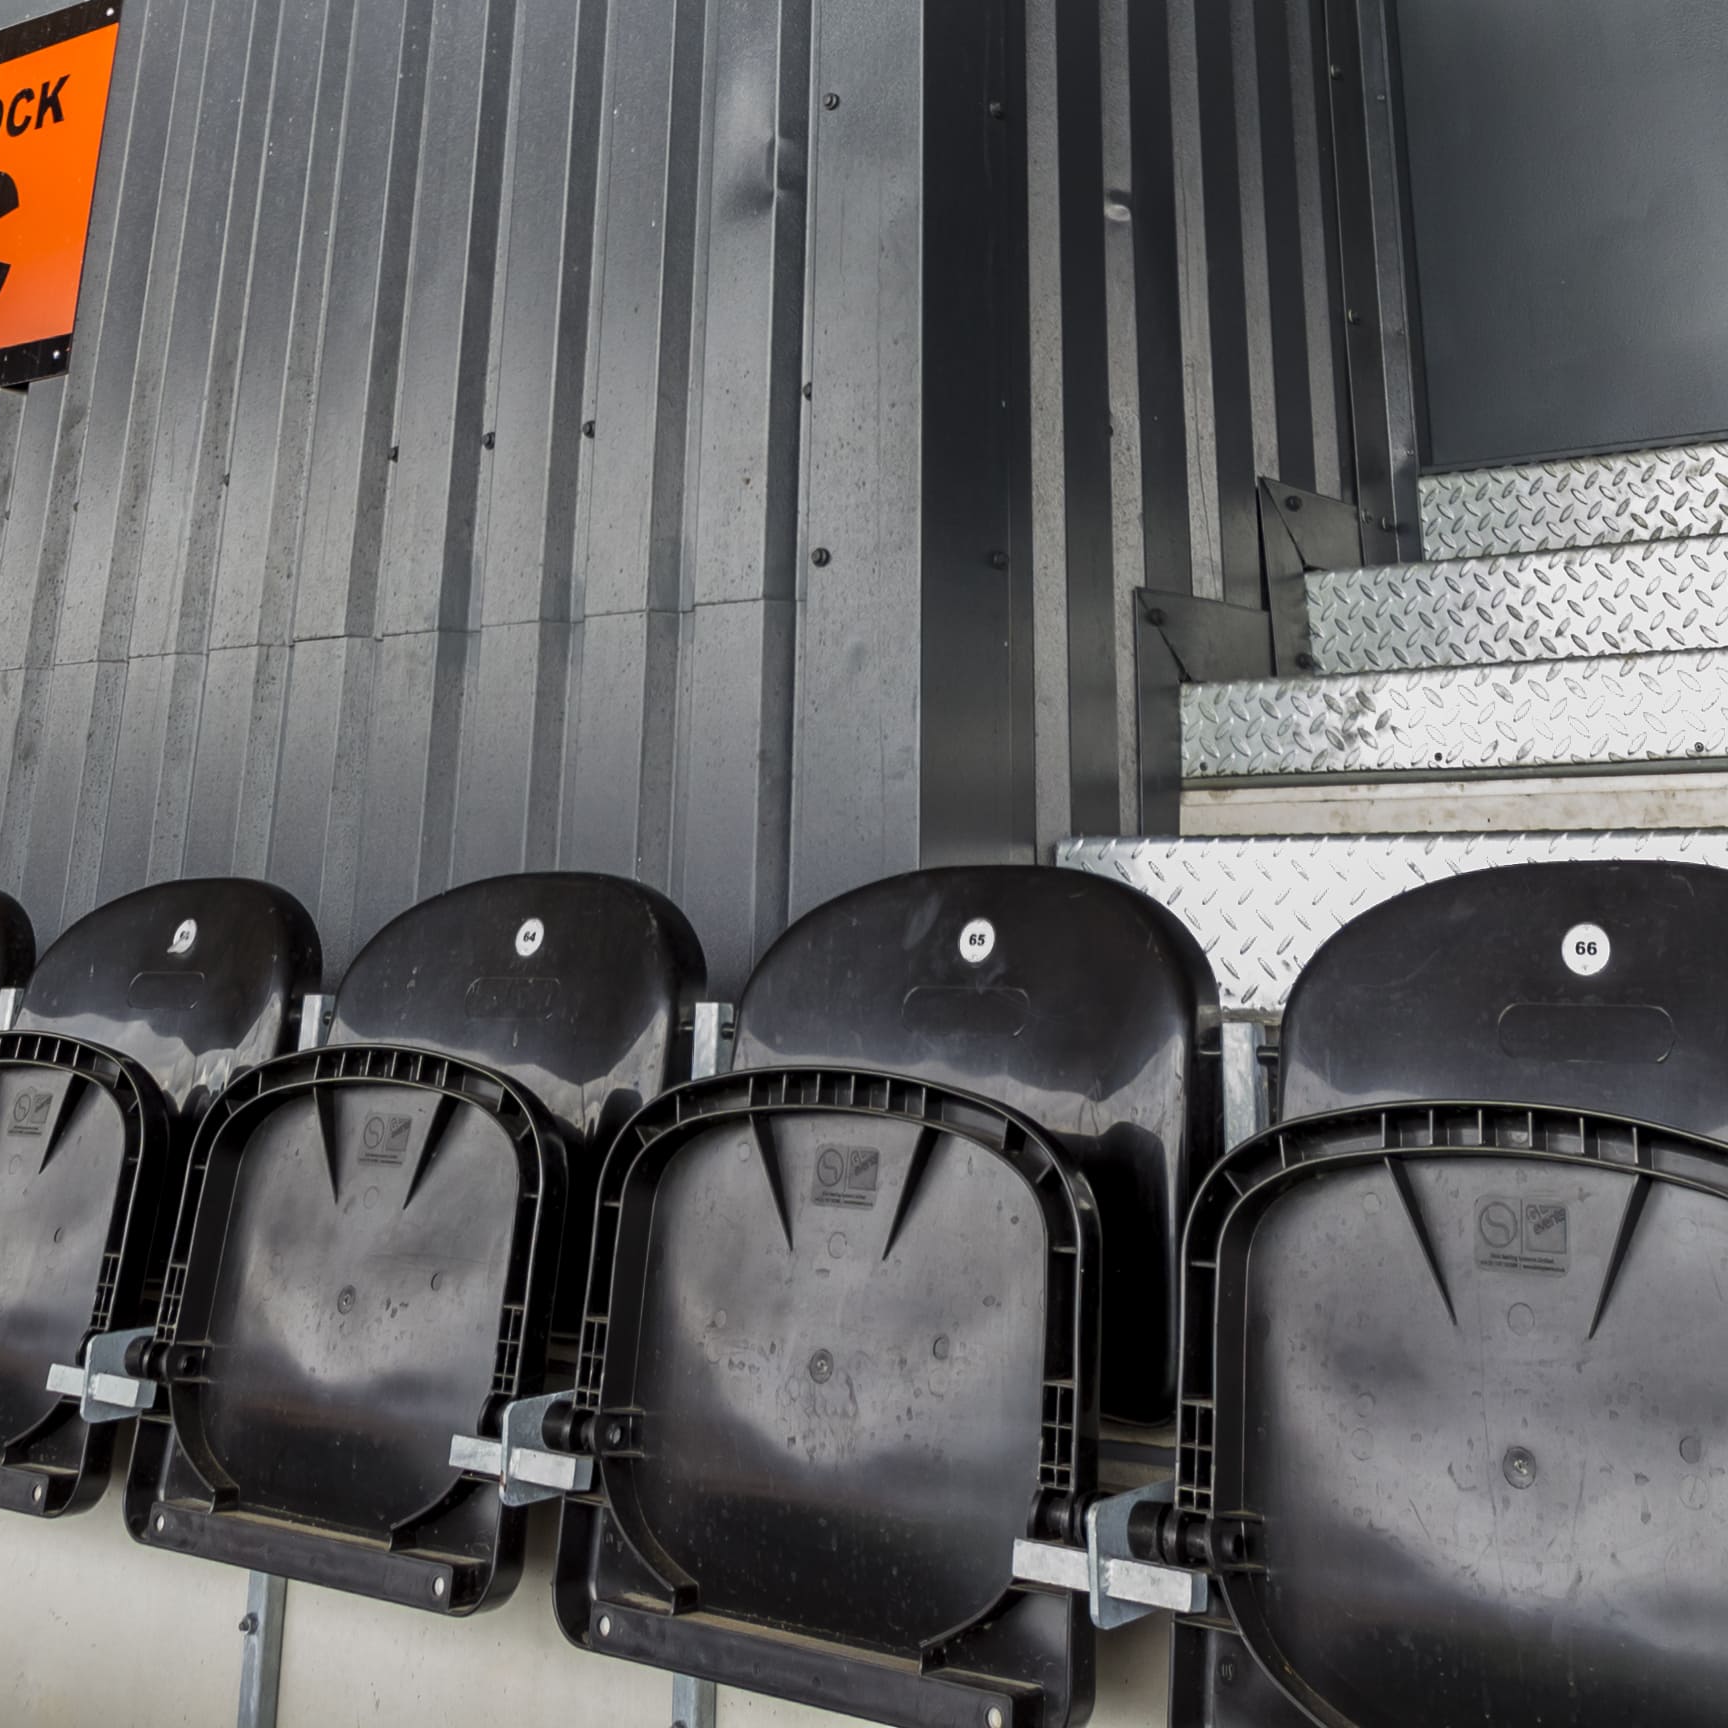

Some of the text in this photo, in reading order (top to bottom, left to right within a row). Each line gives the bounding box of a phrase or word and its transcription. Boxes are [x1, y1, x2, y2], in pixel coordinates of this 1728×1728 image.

[523, 931, 537, 942] 64
[969, 933, 986, 946] 65
[1575, 941, 1598, 956] 66
